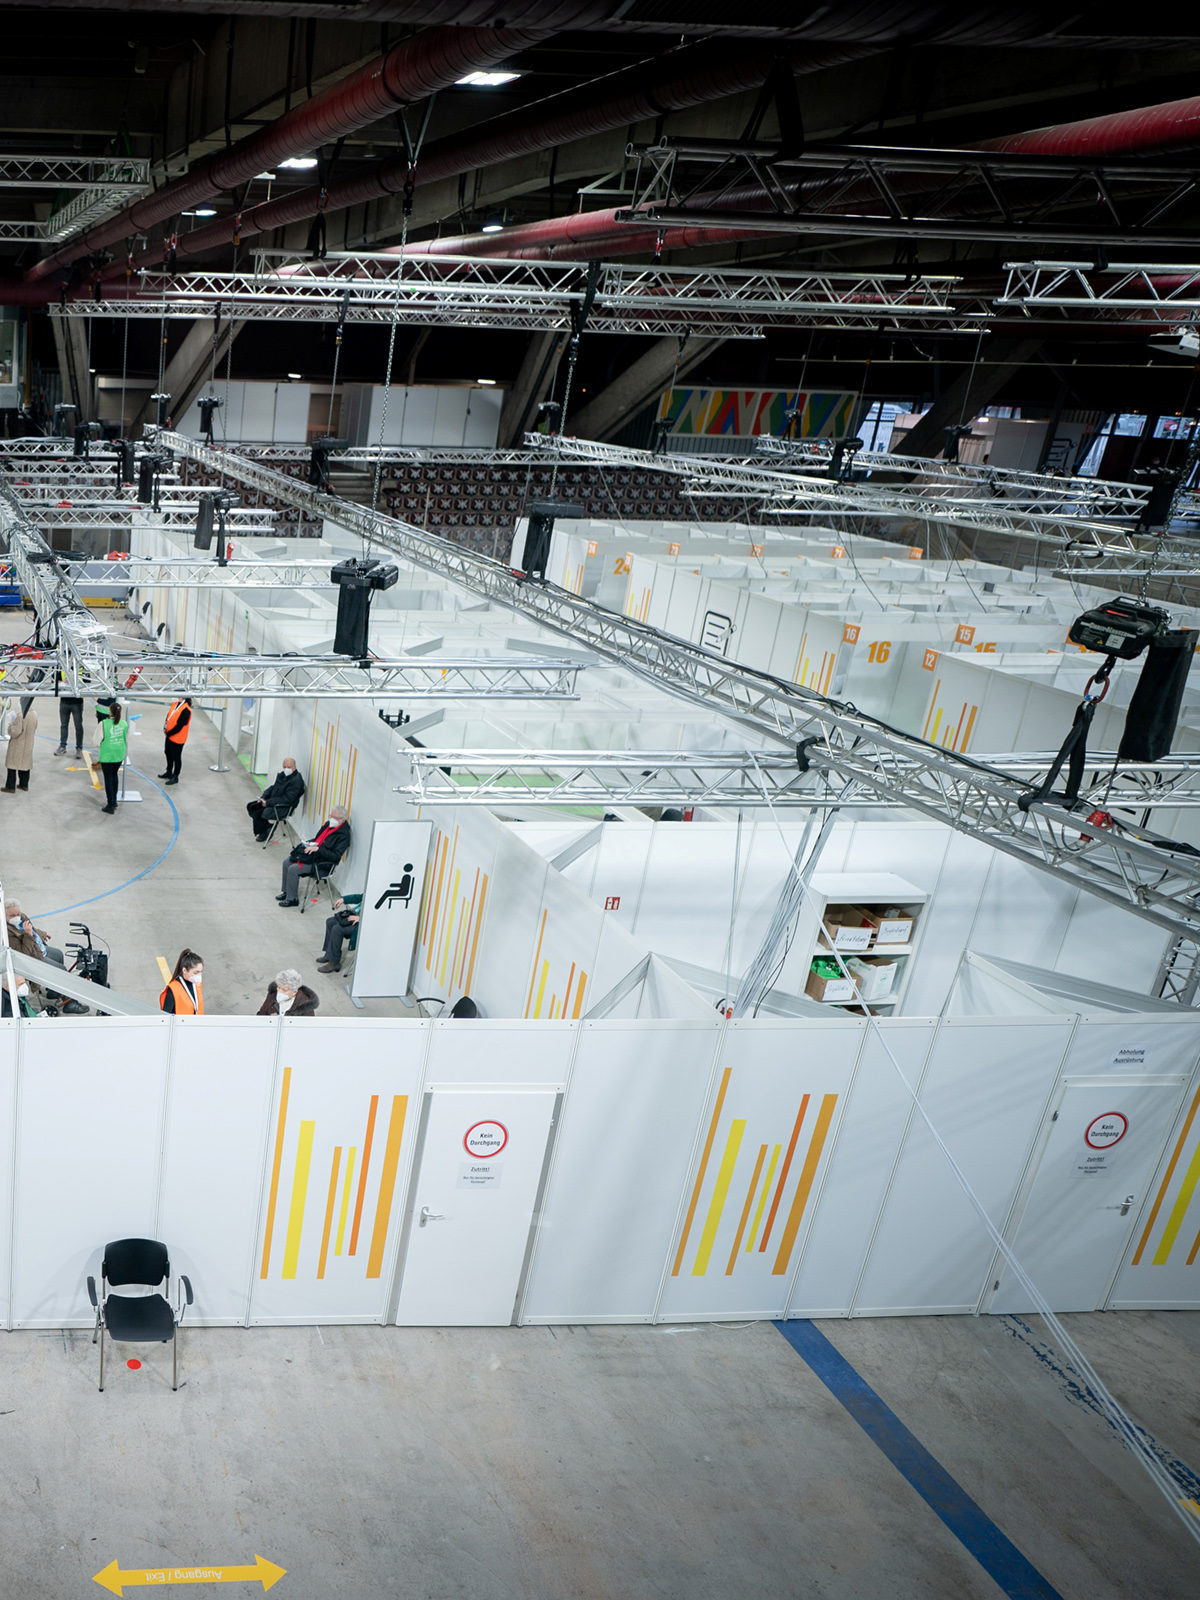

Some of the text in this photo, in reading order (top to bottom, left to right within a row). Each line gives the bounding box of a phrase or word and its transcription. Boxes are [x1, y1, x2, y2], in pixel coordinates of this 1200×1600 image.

[846, 628, 857, 641] 16
[960, 628, 972, 642] 15
[868, 641, 892, 664] 16
[925, 653, 935, 668] 12
[146, 1572, 166, 1582] Exit
[174, 1568, 222, 1580] Ausgang
